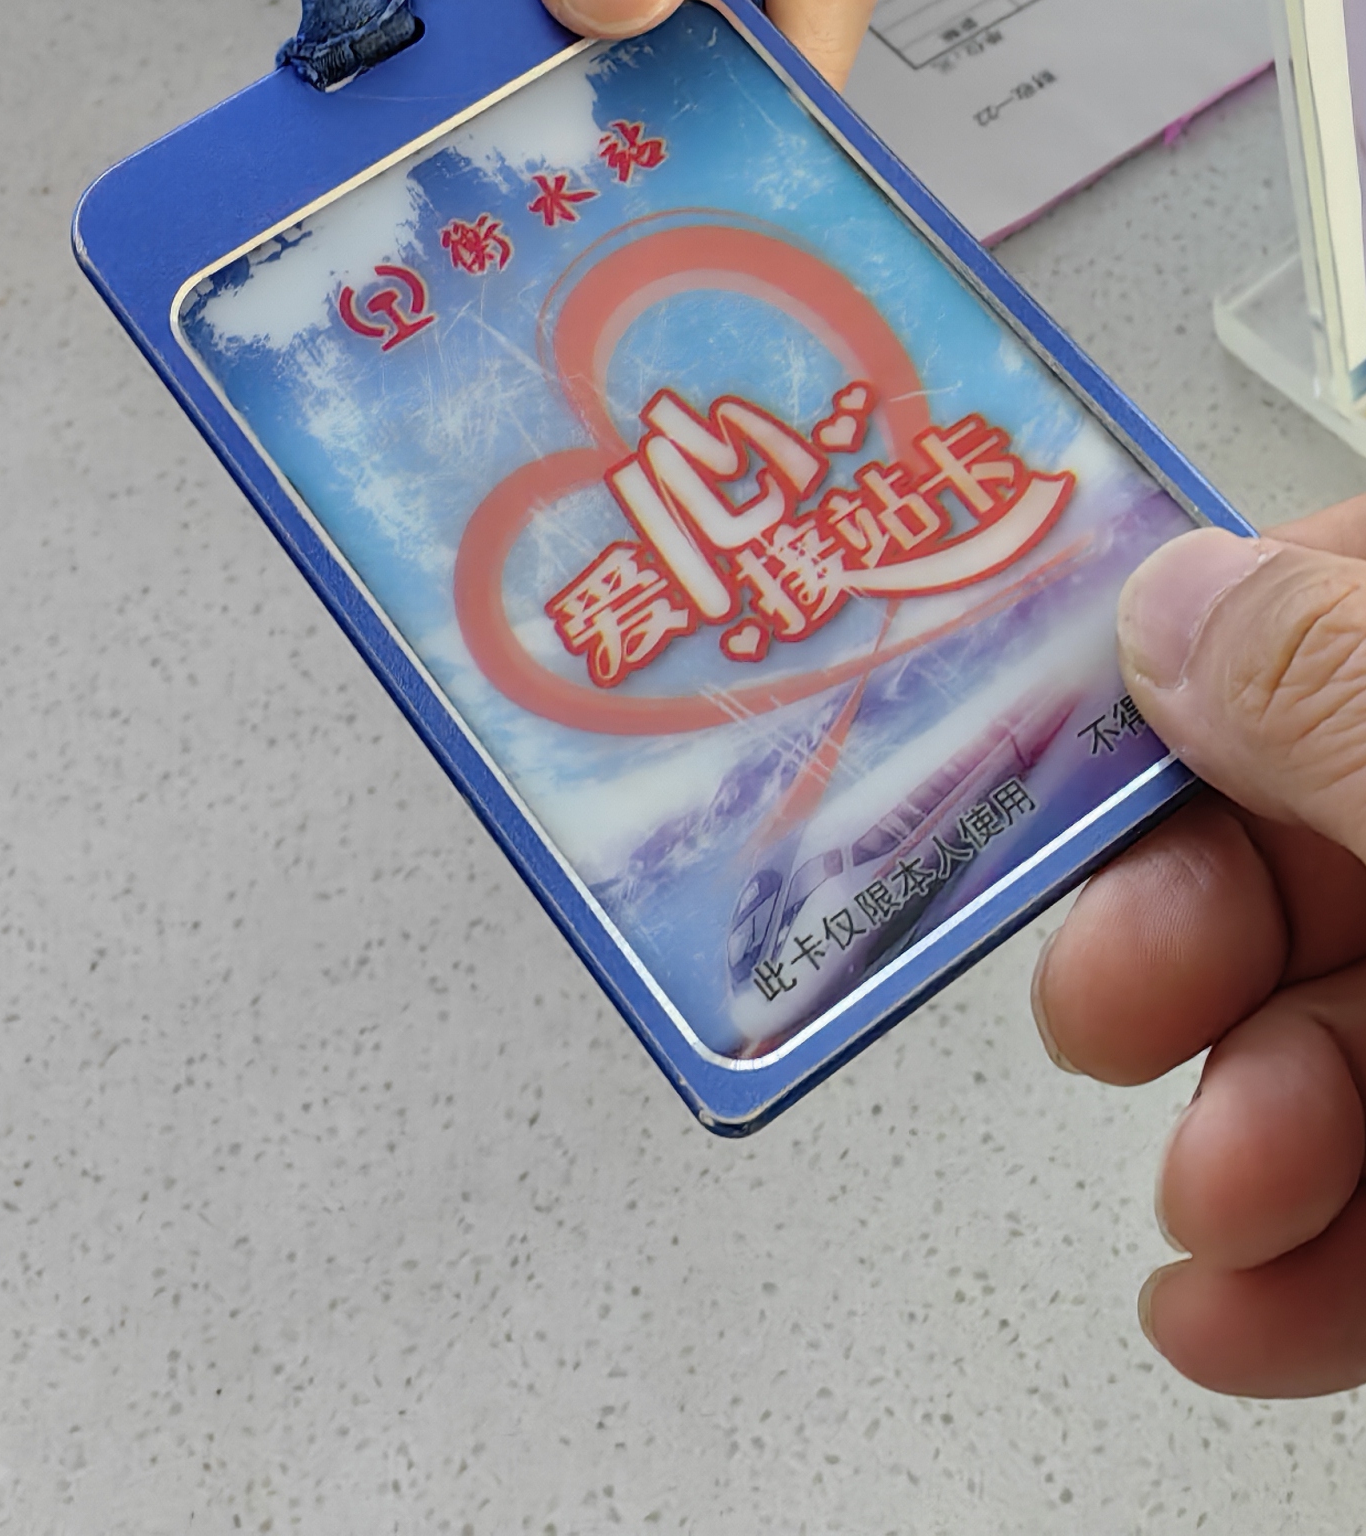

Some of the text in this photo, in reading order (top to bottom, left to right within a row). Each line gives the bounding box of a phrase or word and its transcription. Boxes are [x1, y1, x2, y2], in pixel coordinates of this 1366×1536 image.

[439, 119, 668, 275] 衡水站
[752, 777, 1037, 1002] 此卡仅限本人使用
